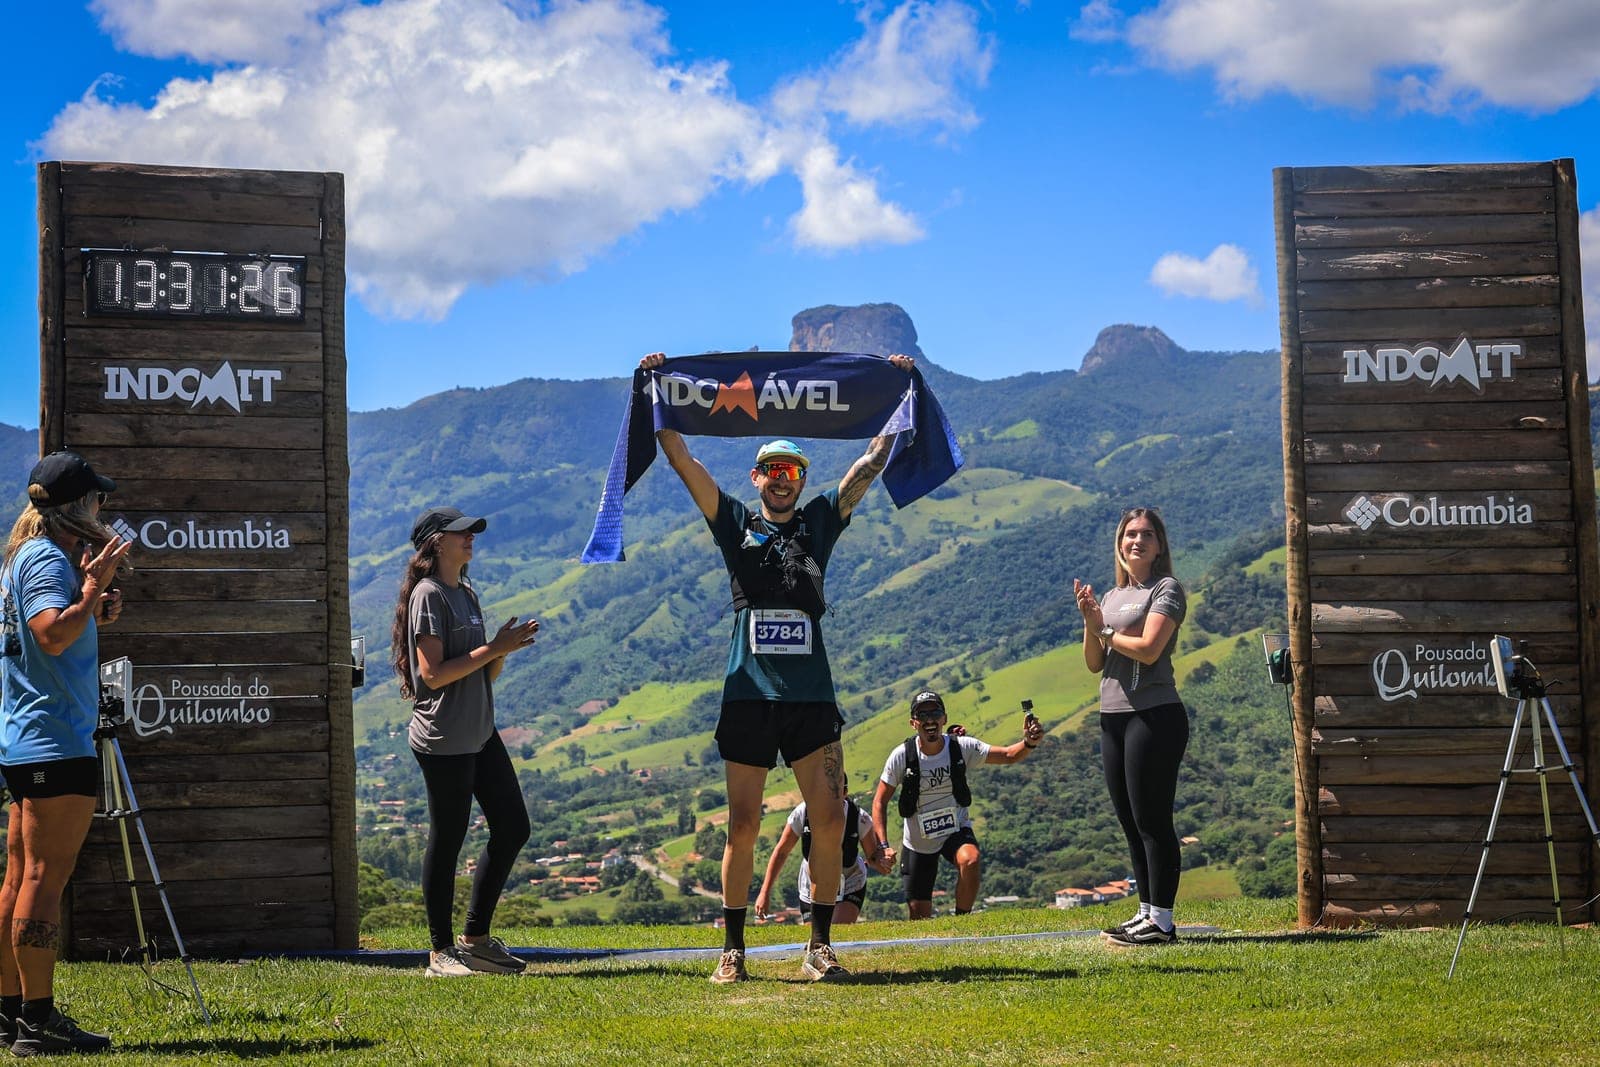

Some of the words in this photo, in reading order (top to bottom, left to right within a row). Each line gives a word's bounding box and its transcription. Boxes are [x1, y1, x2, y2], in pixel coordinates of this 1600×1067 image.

[115, 260, 297, 315] 13:31:26
[1343, 337, 1521, 391] INDOMIT
[104, 360, 282, 414] INDOMIT
[645, 370, 850, 422] NDOMÁVEL
[1382, 496, 1533, 527] Columbia
[140, 519, 291, 549] Columbia
[757, 625, 804, 640] 3784
[1415, 641, 1486, 662] Pousada
[172, 677, 242, 697] Pousada
[248, 677, 269, 697] do
[1373, 649, 1498, 701] Quilomb
[131, 684, 271, 737] Quilombo
[924, 815, 954, 831] 3844
